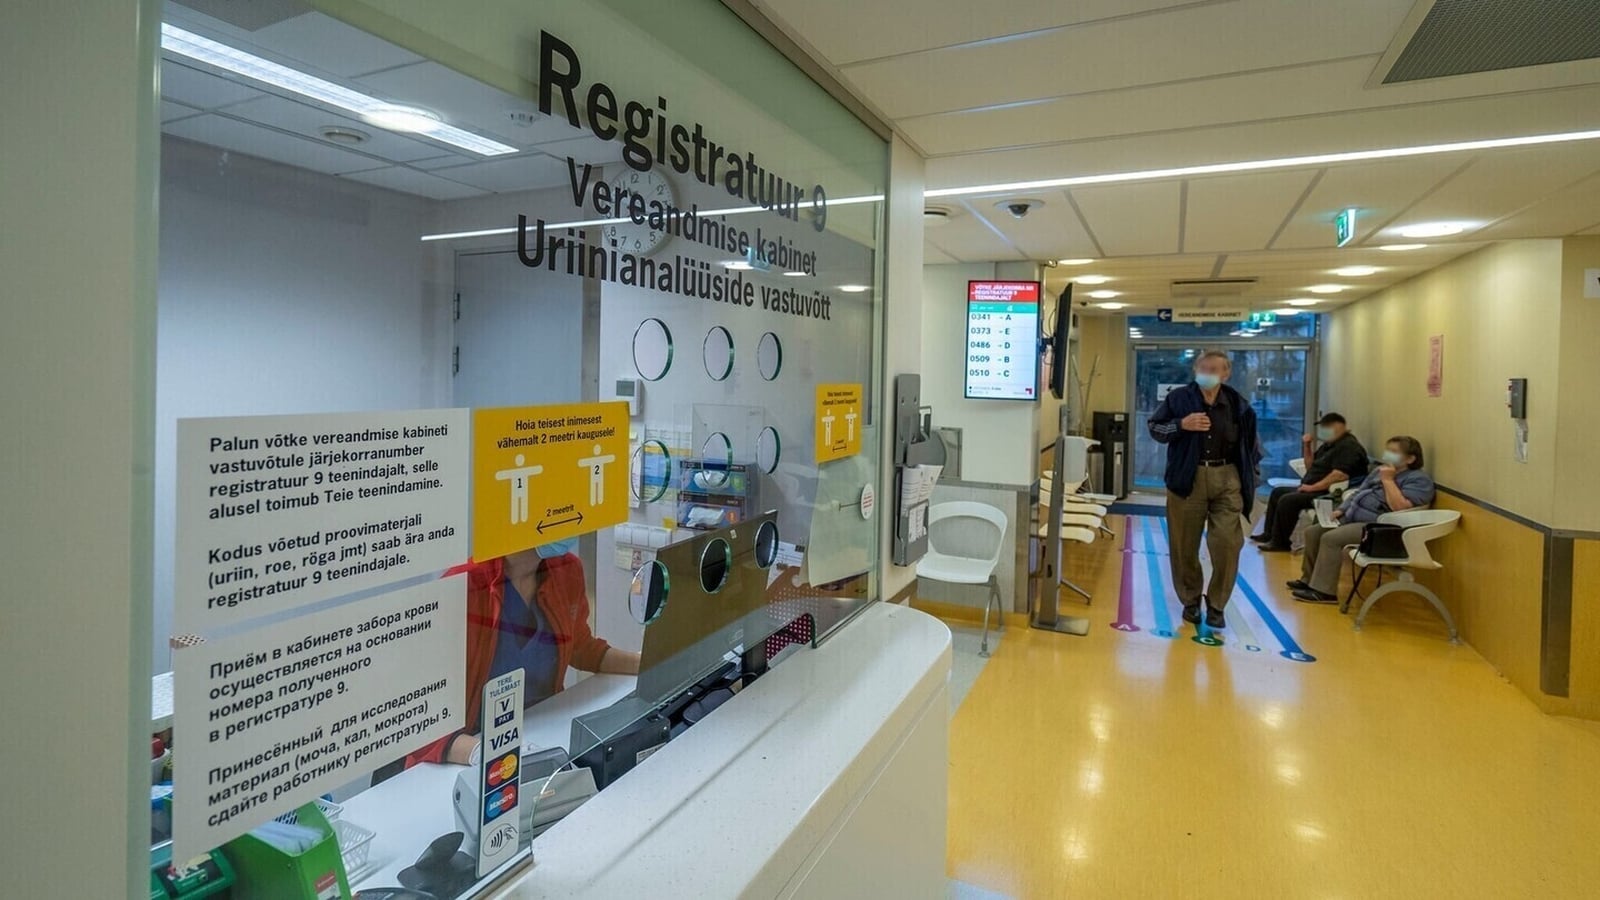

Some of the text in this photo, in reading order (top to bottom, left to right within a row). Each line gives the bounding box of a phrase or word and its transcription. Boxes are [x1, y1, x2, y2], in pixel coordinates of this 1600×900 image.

[539, 29, 828, 233] Registratuur 9
[567, 156, 817, 278] Vereandmise kabinet
[518, 214, 831, 322] Uriinianalüüside vastuvõtt
[210, 424, 448, 452] Palun võtke vereandmise kabineti
[497, 427, 615, 449] vähemalt 2 meetri kaugusele!
[516, 415, 602, 431] Hoia teisest inimesest
[209, 460, 439, 498] registratuur 9 teenindajalt, selle
[210, 445, 424, 475] vastuvõtule järjekorranumber
[594, 465, 600, 475] 2
[209, 478, 443, 519] alusel toimub Teie teenindamine.
[517, 478, 522, 488] 1
[546, 504, 574, 517] 2 meetrit
[208, 514, 422, 564] Kodus võetud proovimaterjali
[208, 526, 455, 590] (uriin, roe, röga jmt) saab ära anda
[208, 554, 410, 609] registratuur 9 teenindajale.
[209, 619, 431, 701] осуществляется на основании
[210, 600, 439, 679] Приём в кабинете забора крови
[208, 656, 371, 722] номера полученного
[490, 680, 521, 698] TULEMAST
[497, 676, 512, 687] TERE
[209, 681, 349, 743] в регистратуре 9.
[498, 714, 512, 724] PAY
[499, 699, 510, 712] V
[208, 678, 447, 785] Принесённый для исследования
[489, 727, 519, 751] VISA
[208, 700, 429, 807] материал (моча, кал, мокрота)
[208, 707, 452, 827] сдайте работнику регистратуры 9.
